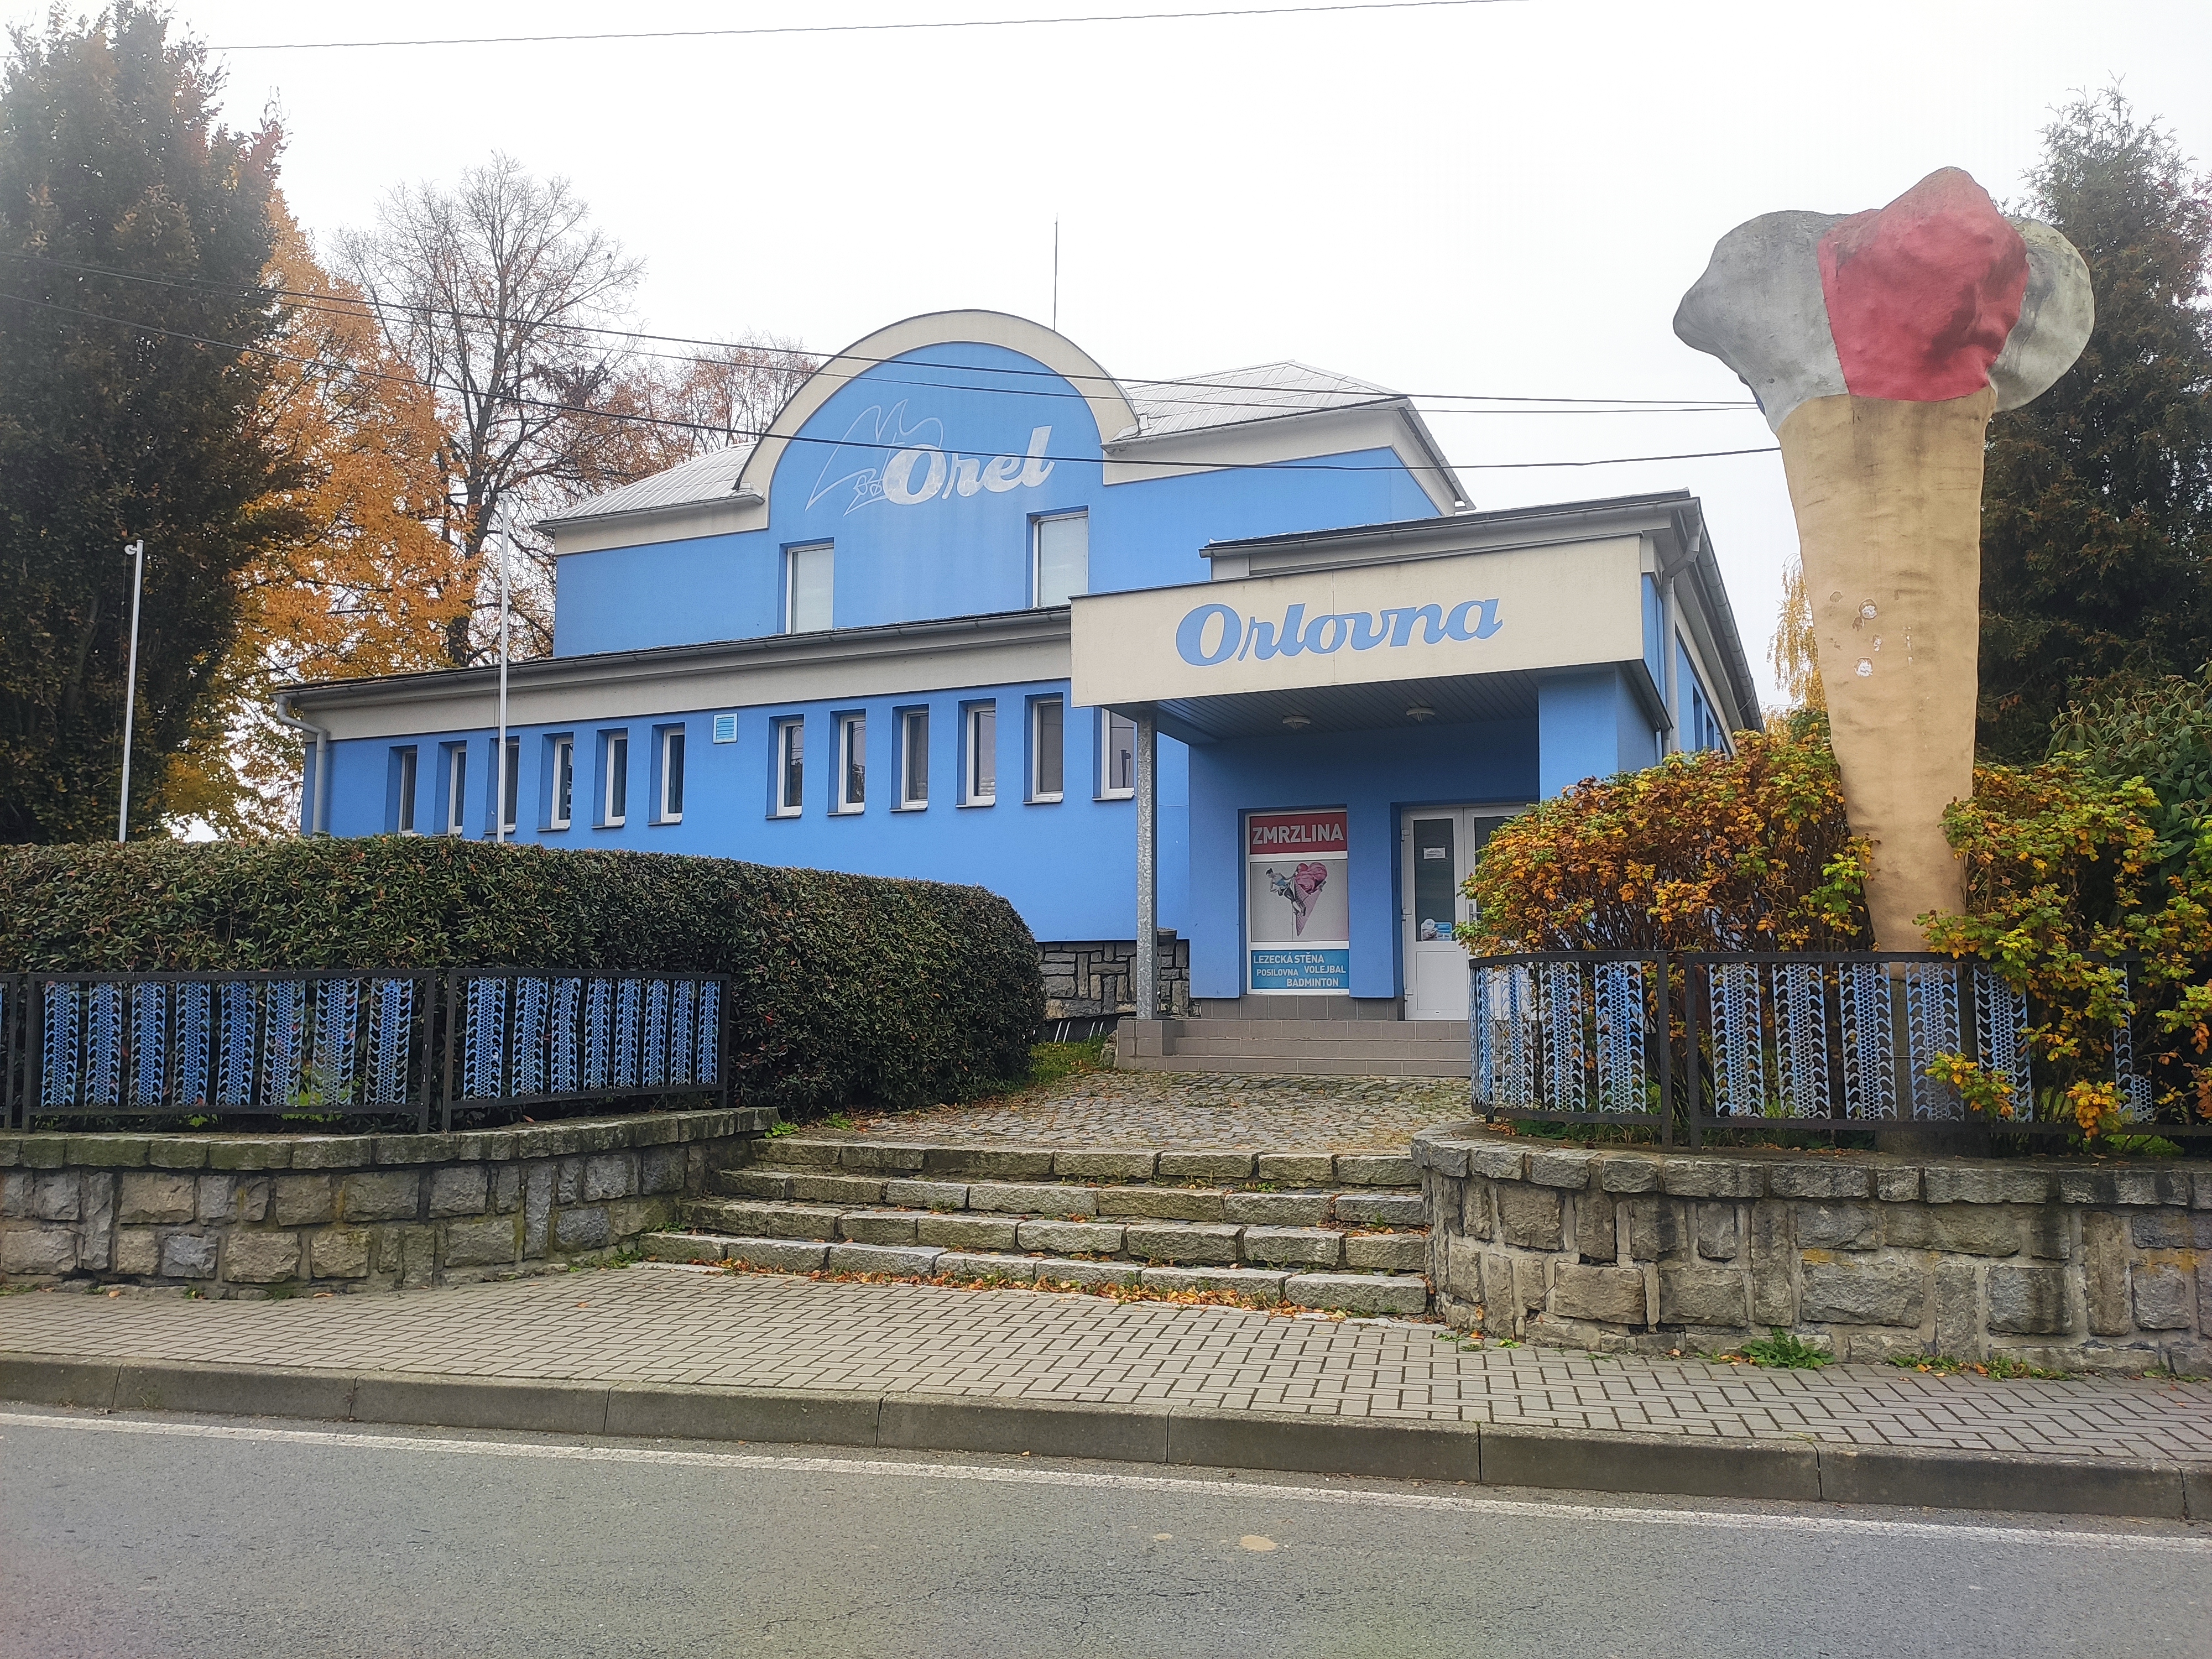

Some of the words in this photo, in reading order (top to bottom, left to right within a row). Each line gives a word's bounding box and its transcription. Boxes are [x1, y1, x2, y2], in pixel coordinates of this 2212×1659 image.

[884, 425, 1055, 505] Orel
[1175, 597, 1504, 666] Orlovna
[1252, 823, 1344, 844] ZMRZLINA
[1253, 952, 1293, 964] LEZECKÁ
[1294, 951, 1325, 963] STĚNA
[1256, 968, 1299, 977] POSILOVNA
[1304, 965, 1347, 974] VOLEJBAL
[1286, 978, 1339, 987] BADMINTON
